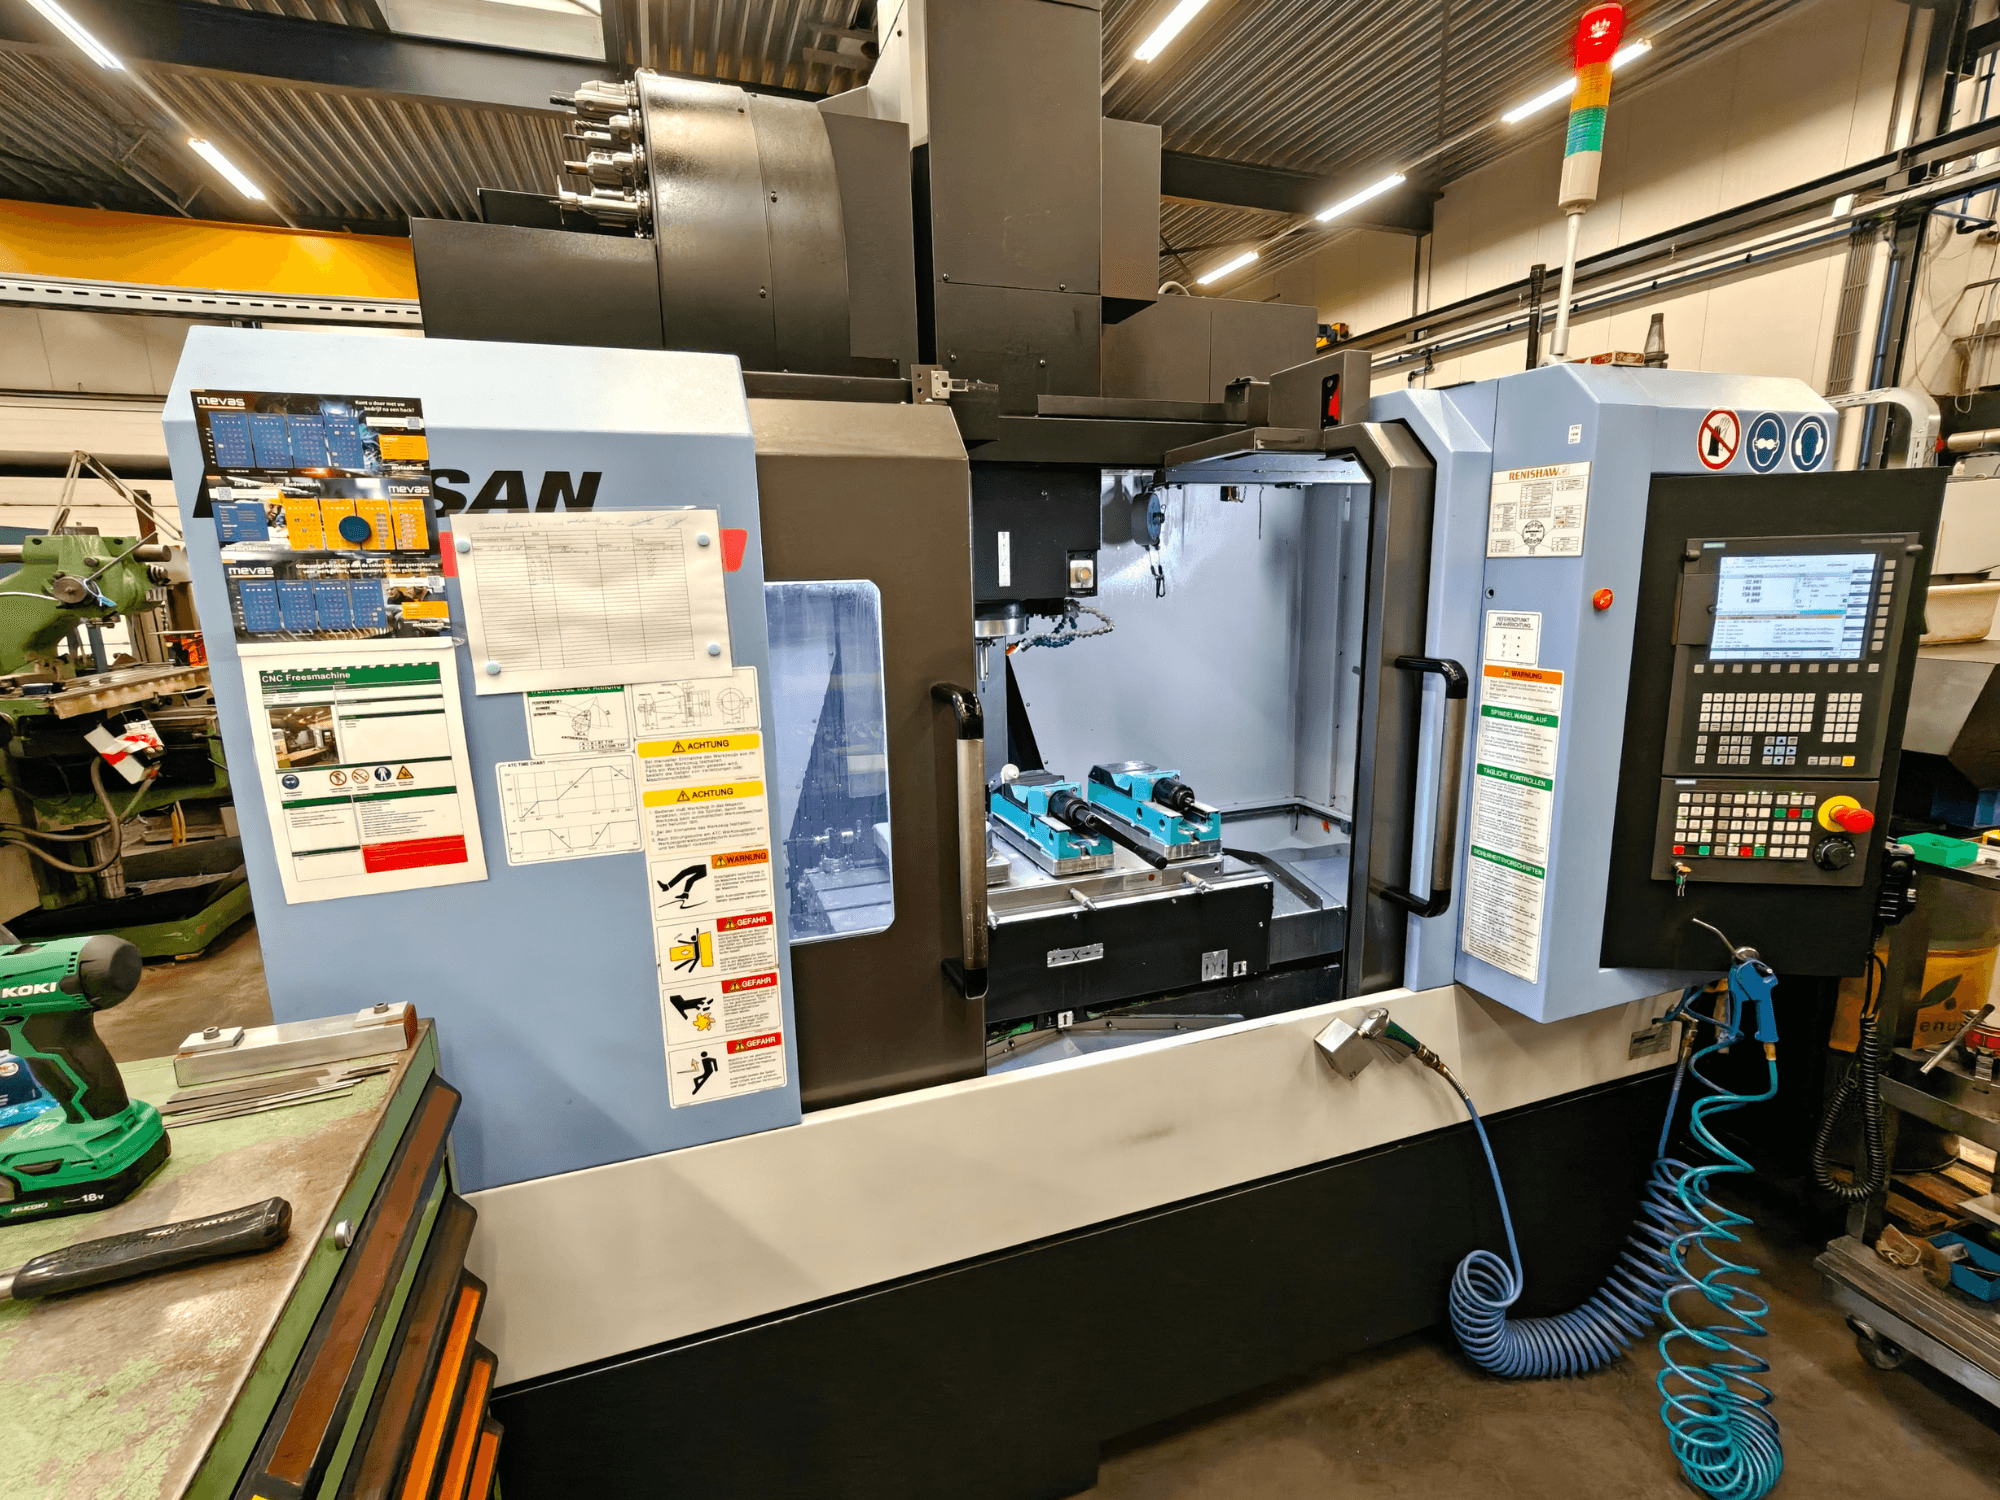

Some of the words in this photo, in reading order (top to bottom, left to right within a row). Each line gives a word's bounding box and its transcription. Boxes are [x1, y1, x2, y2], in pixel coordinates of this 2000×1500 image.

[196, 397, 245, 406] mevas
[1509, 467, 1559, 481] RENISHAW
[388, 485, 429, 494] mevas
[228, 566, 274, 575] mevas
[286, 672, 350, 681] Freesmachine
[1512, 671, 1542, 679] WARNUNG
[688, 740, 729, 750] ACHTUNG
[1510, 773, 1546, 787] KONTROLLEN
[692, 788, 733, 799] ACHTUNG
[726, 853, 766, 863] WARNUNG
[737, 916, 767, 926] GEFAHR
[1072, 950, 1080, 961] X
[741, 977, 771, 988] GEFAHR
[2, 982, 57, 998] KOKI
[1920, 1020, 1963, 1033] enu
[746, 1036, 776, 1048] GEFAHR
